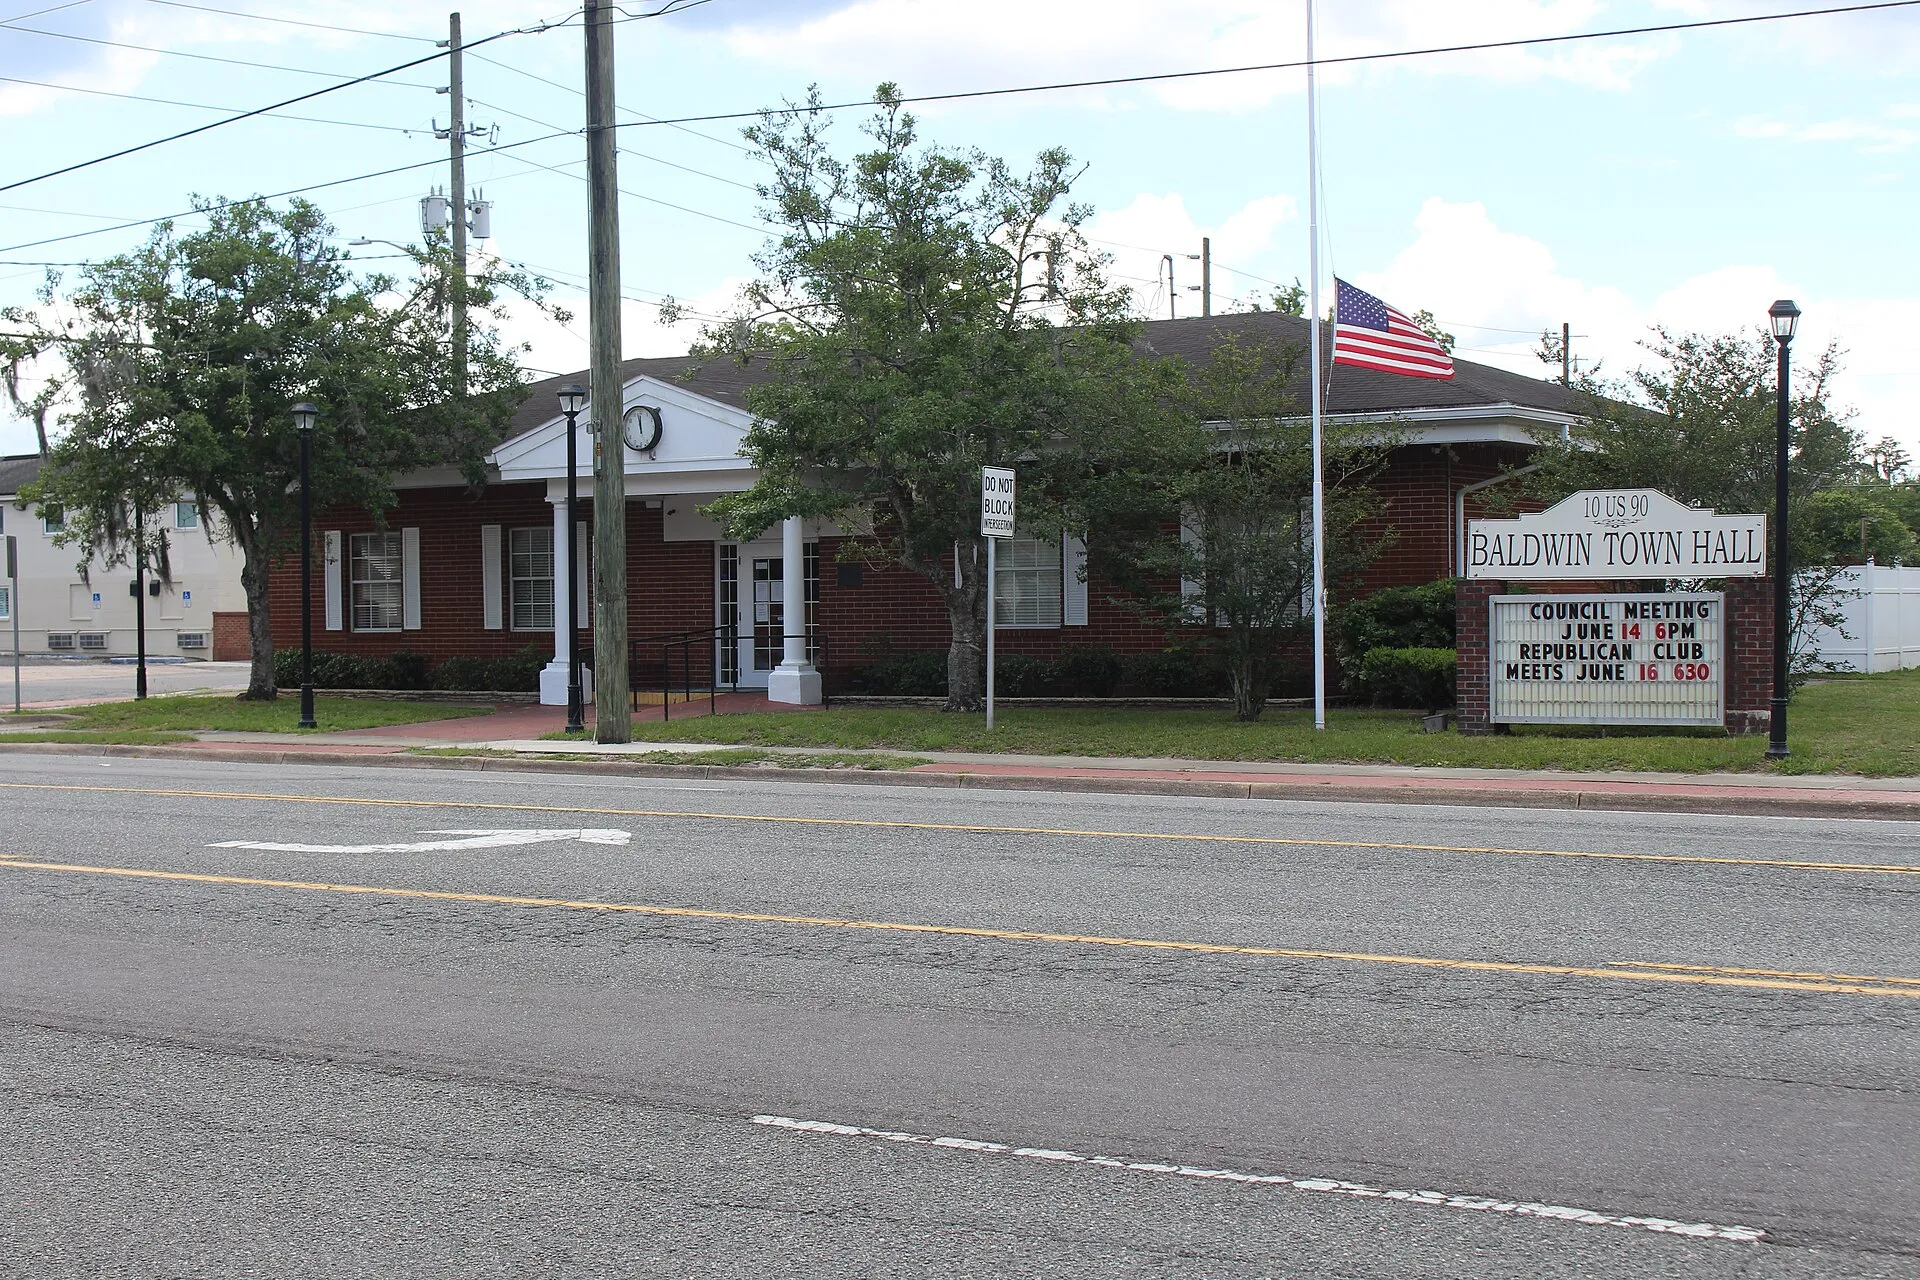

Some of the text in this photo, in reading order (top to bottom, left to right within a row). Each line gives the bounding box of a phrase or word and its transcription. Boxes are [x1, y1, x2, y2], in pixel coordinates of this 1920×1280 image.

[985, 476, 1014, 493] DO NOT
[984, 498, 1013, 516] BLOCK
[1584, 494, 1649, 518] 10 US 90
[1471, 529, 1763, 567] BALDWIN TOWN HALL
[1530, 601, 1709, 620] COUNCIL MEETING
[1561, 622, 1695, 640] JUNE 14 6PM
[1519, 642, 1704, 661] REPUBLICAN CLUB
[1506, 663, 1710, 681] MEETS JUNE 16 630
